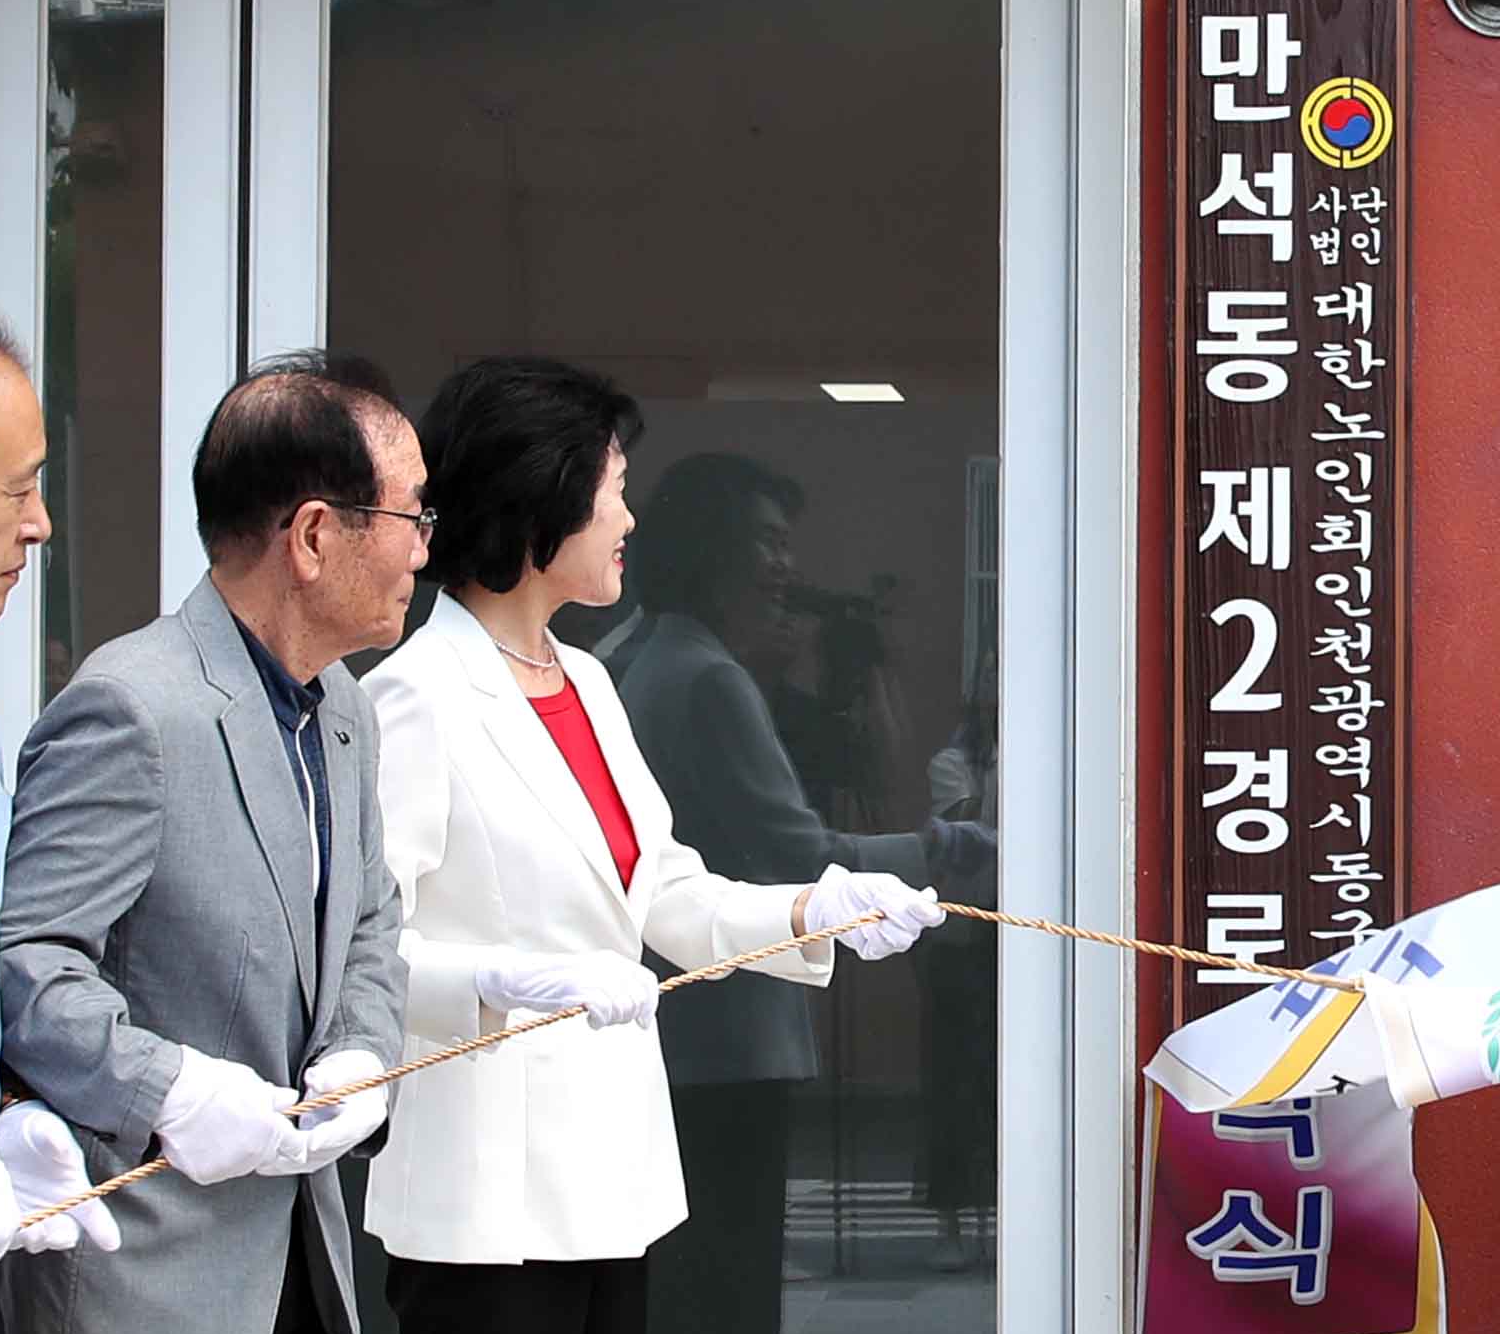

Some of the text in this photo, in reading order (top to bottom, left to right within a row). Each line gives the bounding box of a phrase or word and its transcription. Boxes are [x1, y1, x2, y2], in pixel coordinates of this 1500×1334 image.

[1195, 12, 1302, 404] 만석동
[1308, 186, 1388, 226] 사단
[1308, 225, 1382, 267] 법인
